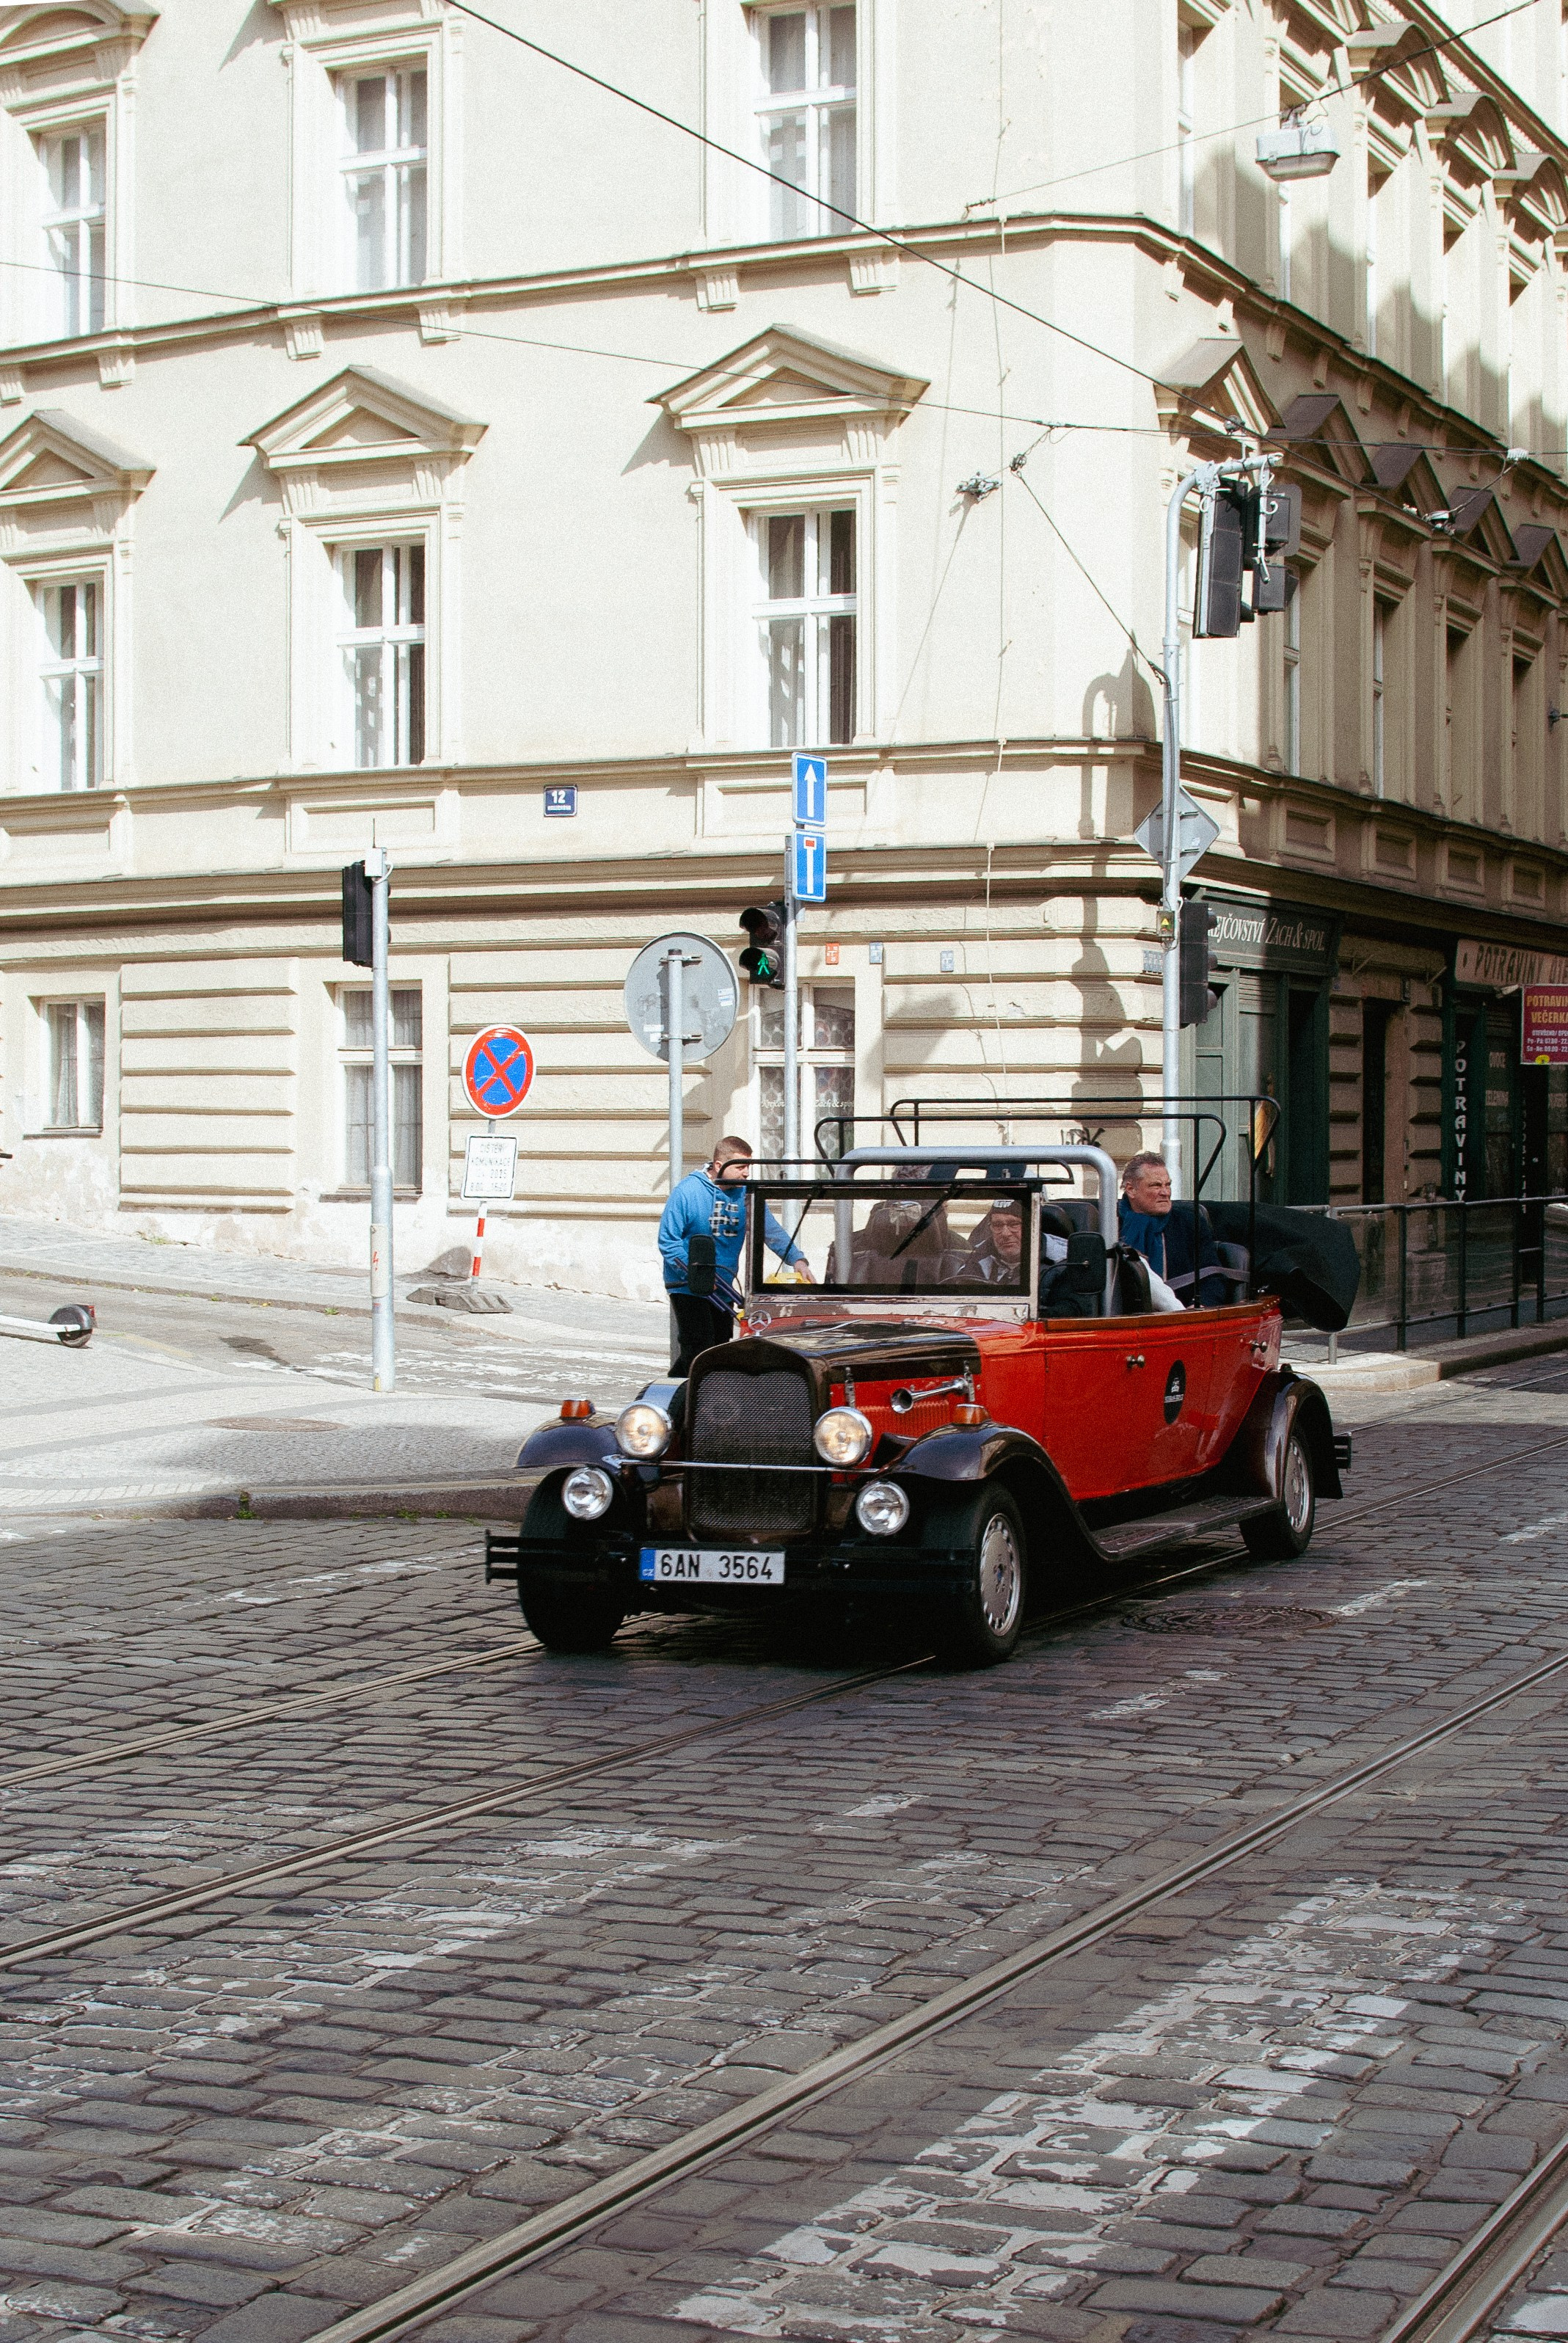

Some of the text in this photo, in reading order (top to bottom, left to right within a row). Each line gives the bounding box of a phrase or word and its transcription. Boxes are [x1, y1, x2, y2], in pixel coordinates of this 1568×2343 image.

[551, 790, 566, 804] 12
[1208, 912, 1266, 944] EJČOVSTVÍ
[1292, 922, 1303, 948] &
[1475, 944, 1543, 984] POTRAVINY
[1455, 1040, 1467, 1202] POTRAVINY
[642, 1568, 654, 1576] CZ
[661, 1553, 773, 1580] 6AN 3564
